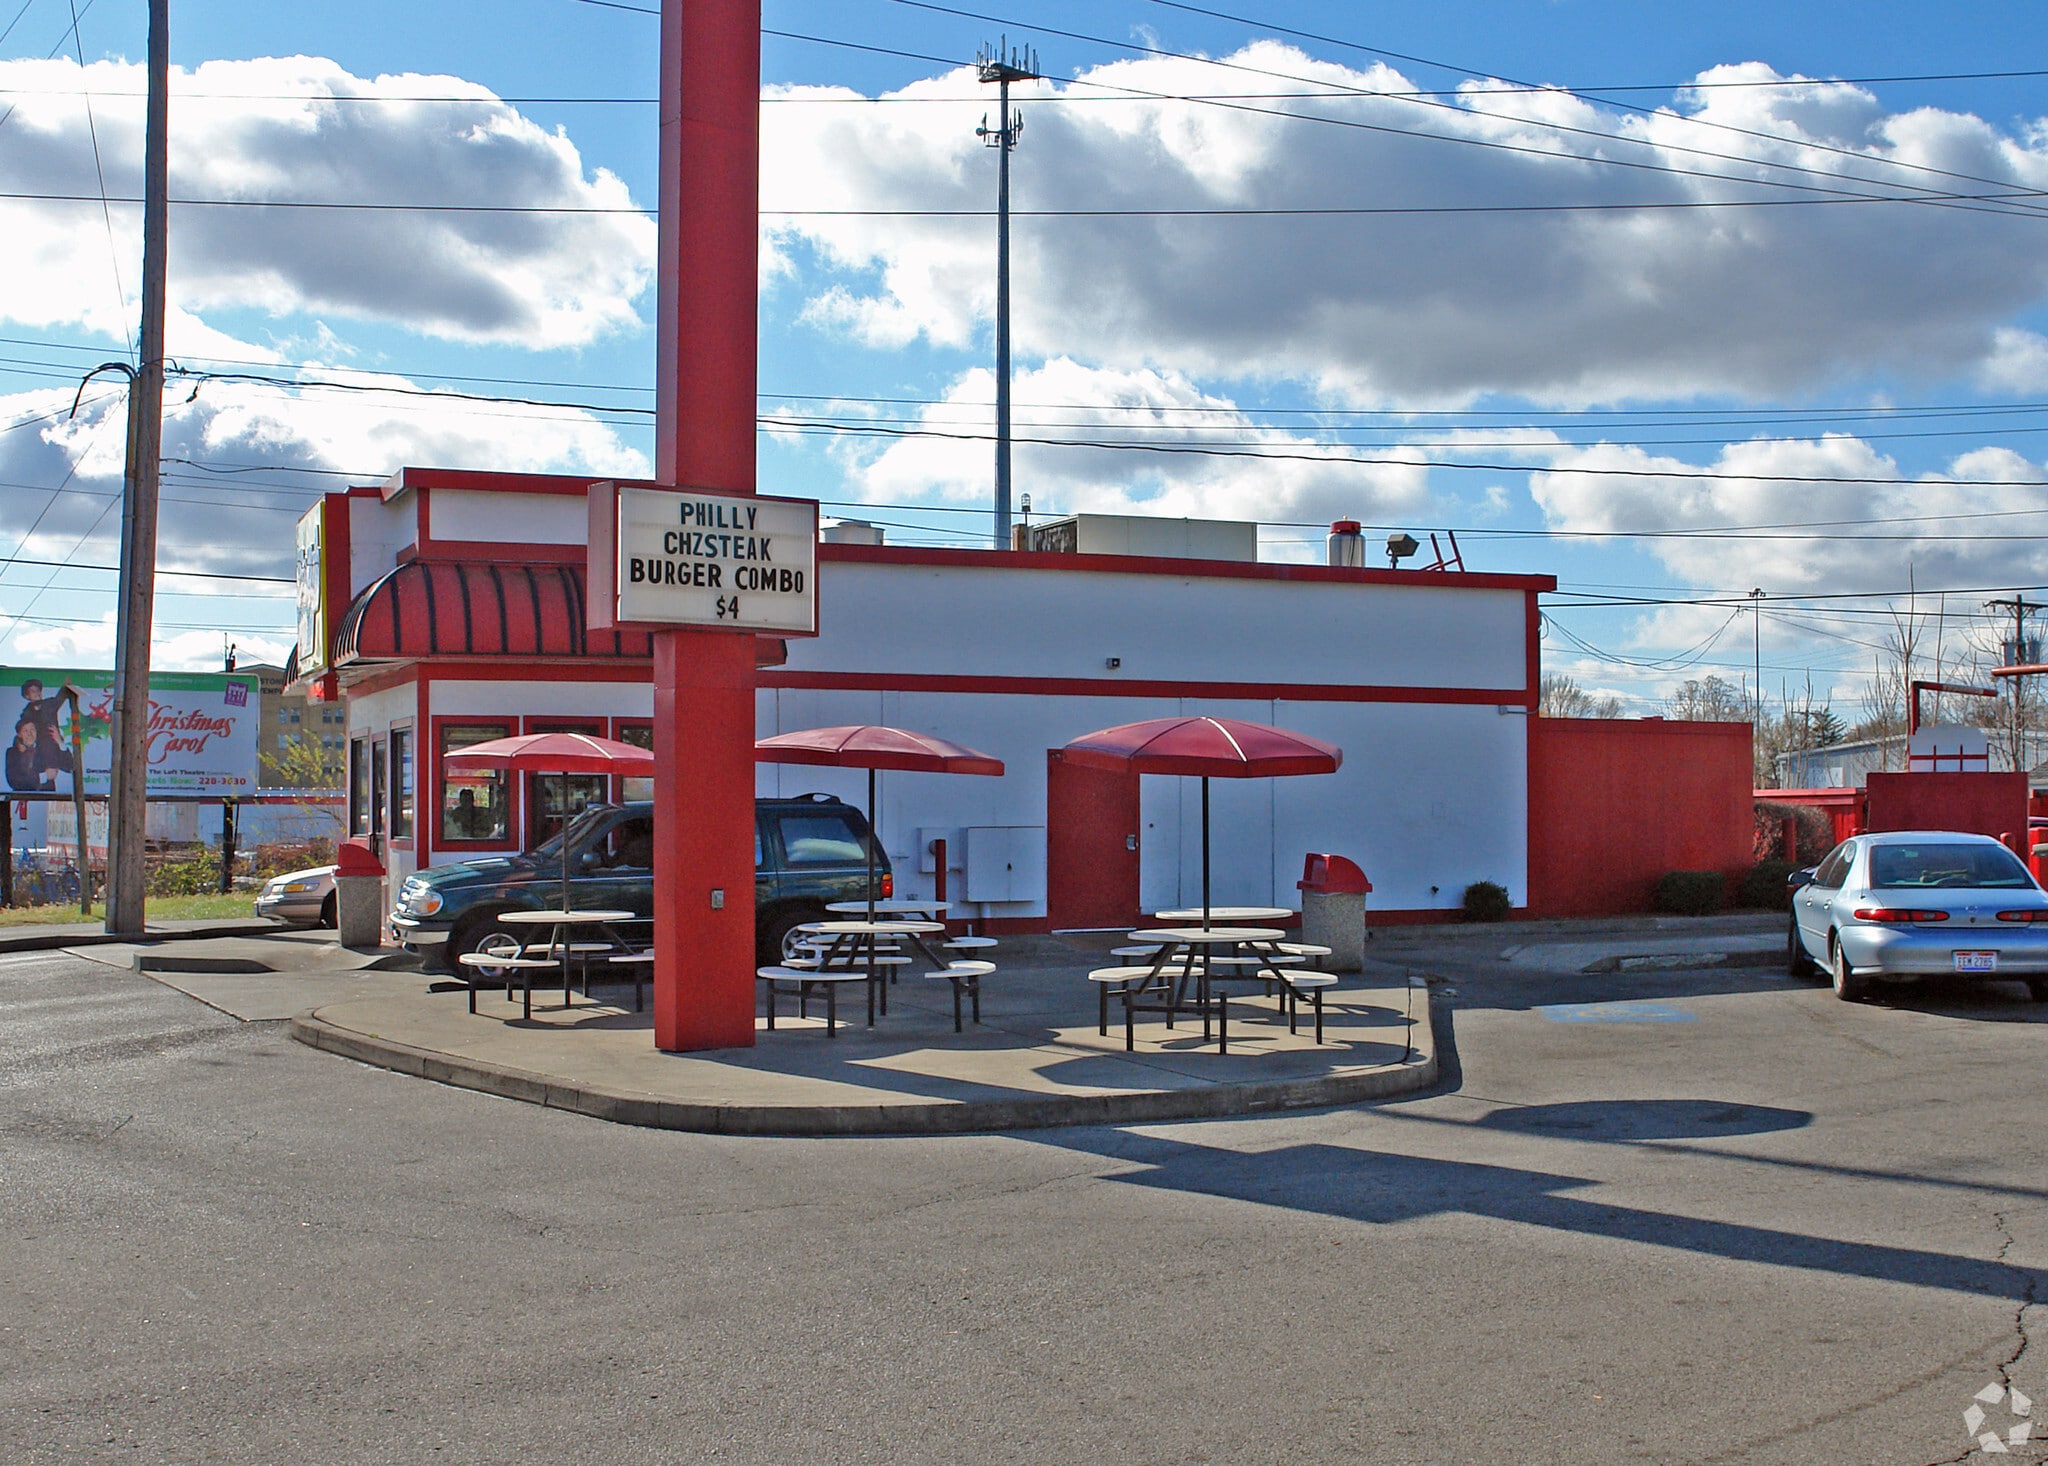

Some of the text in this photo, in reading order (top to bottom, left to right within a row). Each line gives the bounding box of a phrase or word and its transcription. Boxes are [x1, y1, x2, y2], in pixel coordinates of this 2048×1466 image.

[680, 502, 757, 530] PHILLY
[664, 531, 772, 562] CHZSTEAK
[630, 558, 804, 593] BURGER COMBO
[716, 595, 740, 619] $4
[145, 731, 221, 764] Carol
